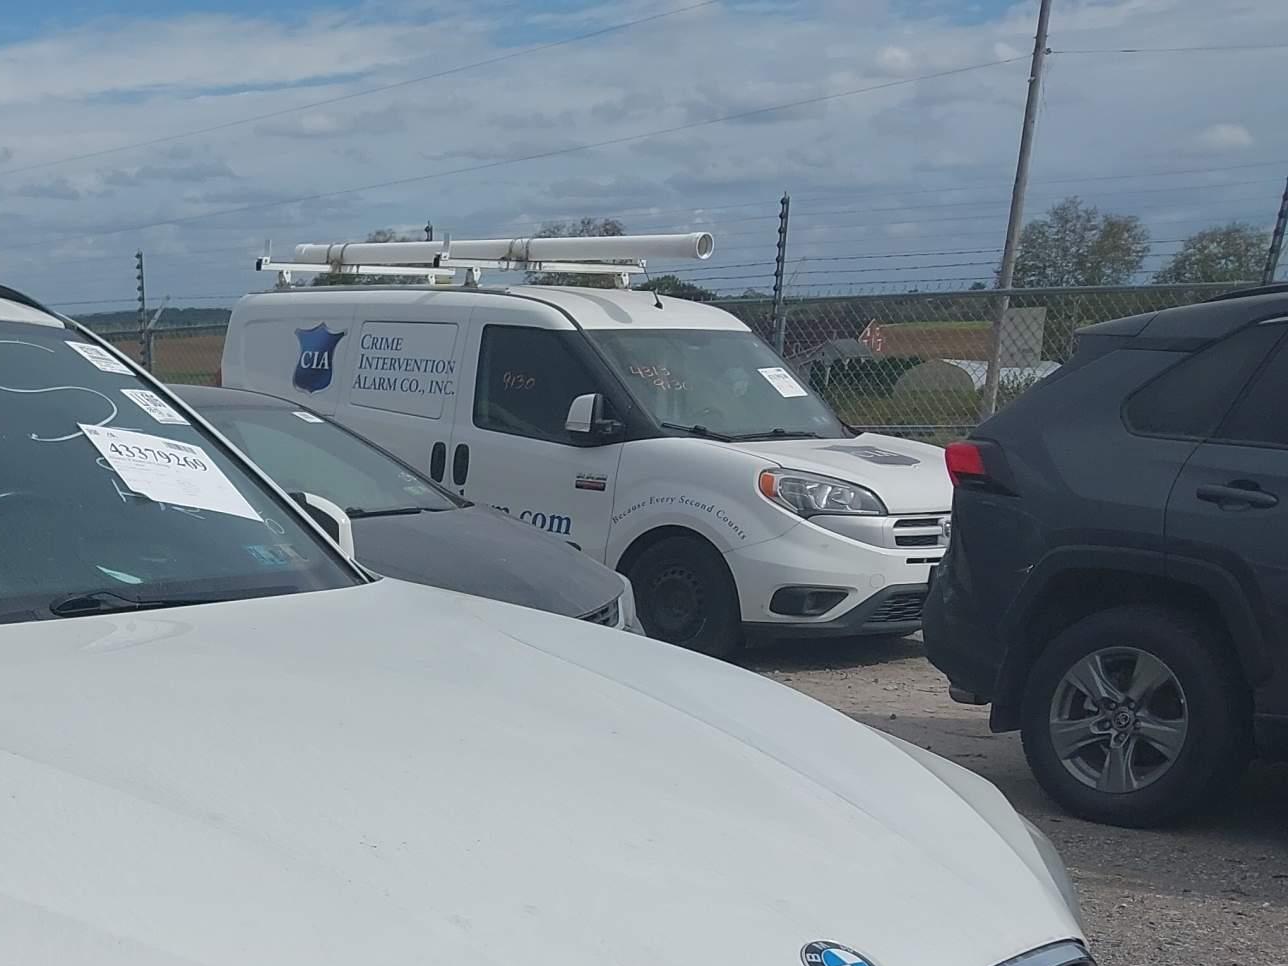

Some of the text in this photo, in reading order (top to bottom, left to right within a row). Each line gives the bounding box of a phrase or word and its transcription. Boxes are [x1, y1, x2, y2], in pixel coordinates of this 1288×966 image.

[300, 350, 329, 370] CIA
[429, 380, 455, 396] INC.
[109, 442, 208, 472] 43379269
[612, 495, 747, 540] Because Every Second Counts
